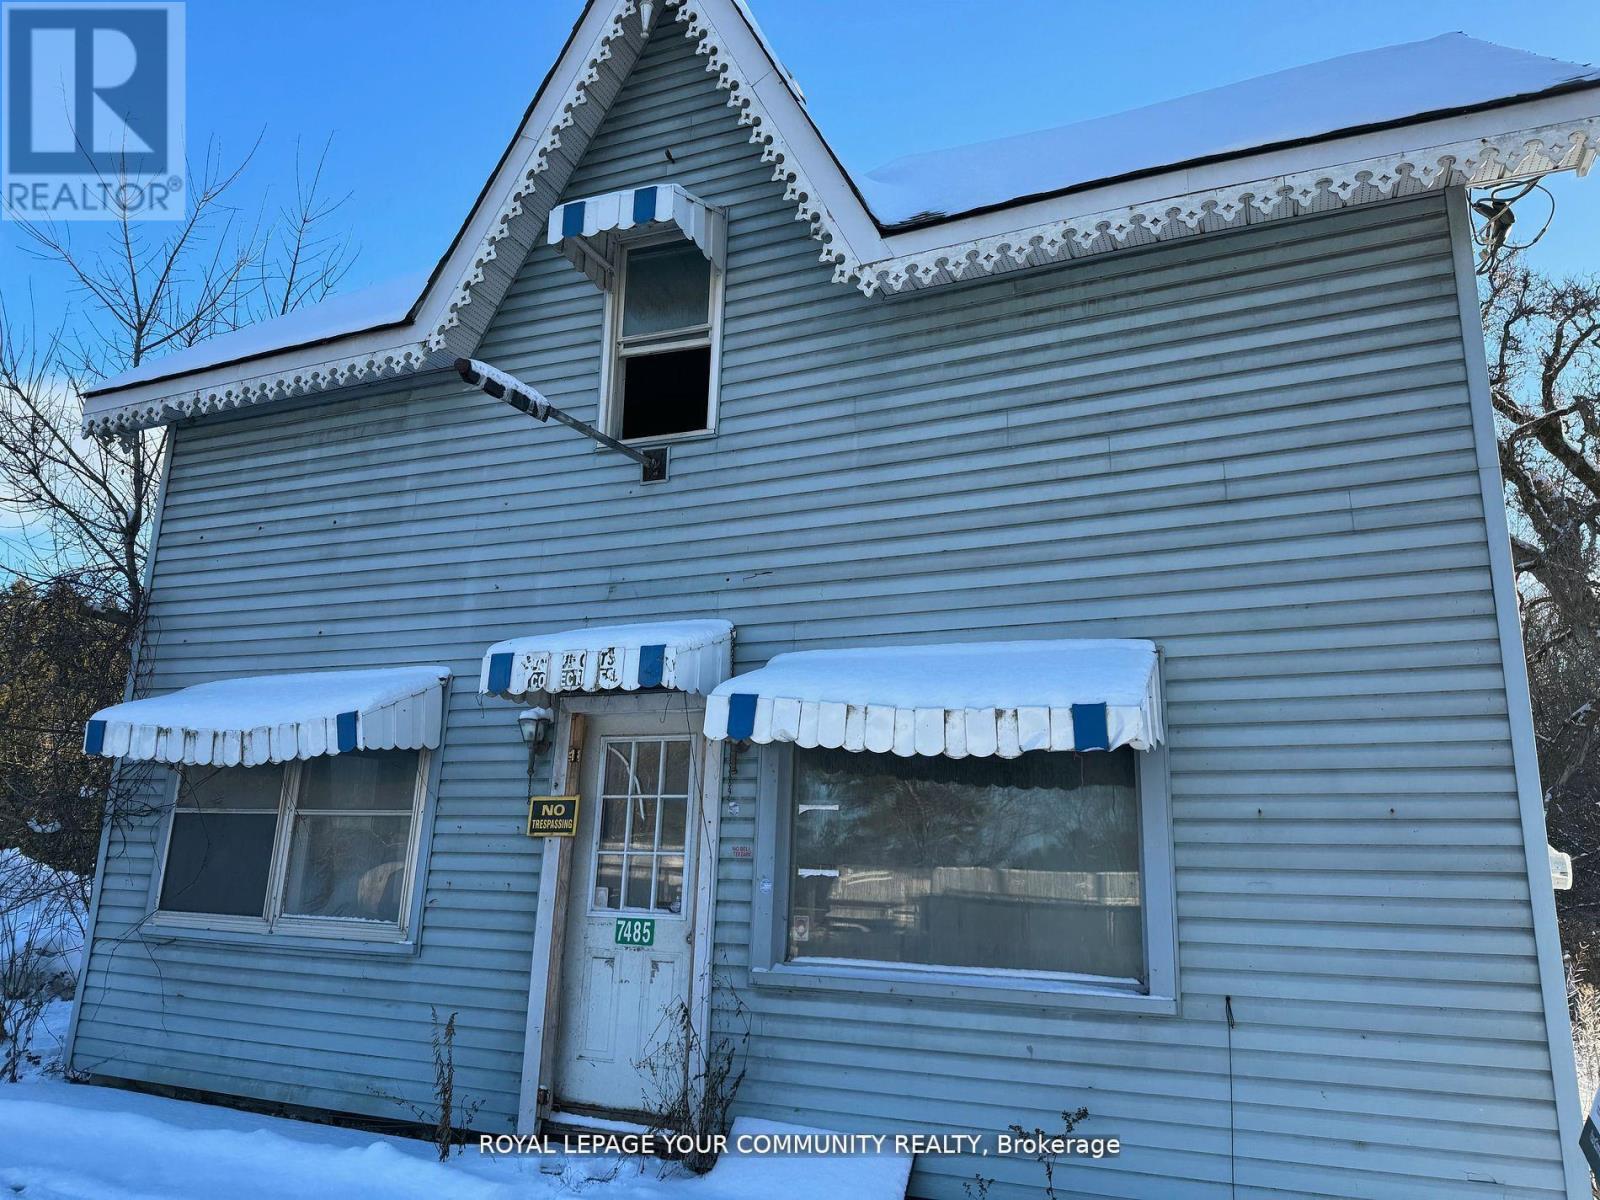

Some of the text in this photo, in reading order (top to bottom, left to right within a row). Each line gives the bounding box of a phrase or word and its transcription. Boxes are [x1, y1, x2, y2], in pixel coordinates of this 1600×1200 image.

[541, 804, 566, 816] NO
[532, 819, 573, 829] TRESPASSING
[617, 920, 651, 943] 7485
